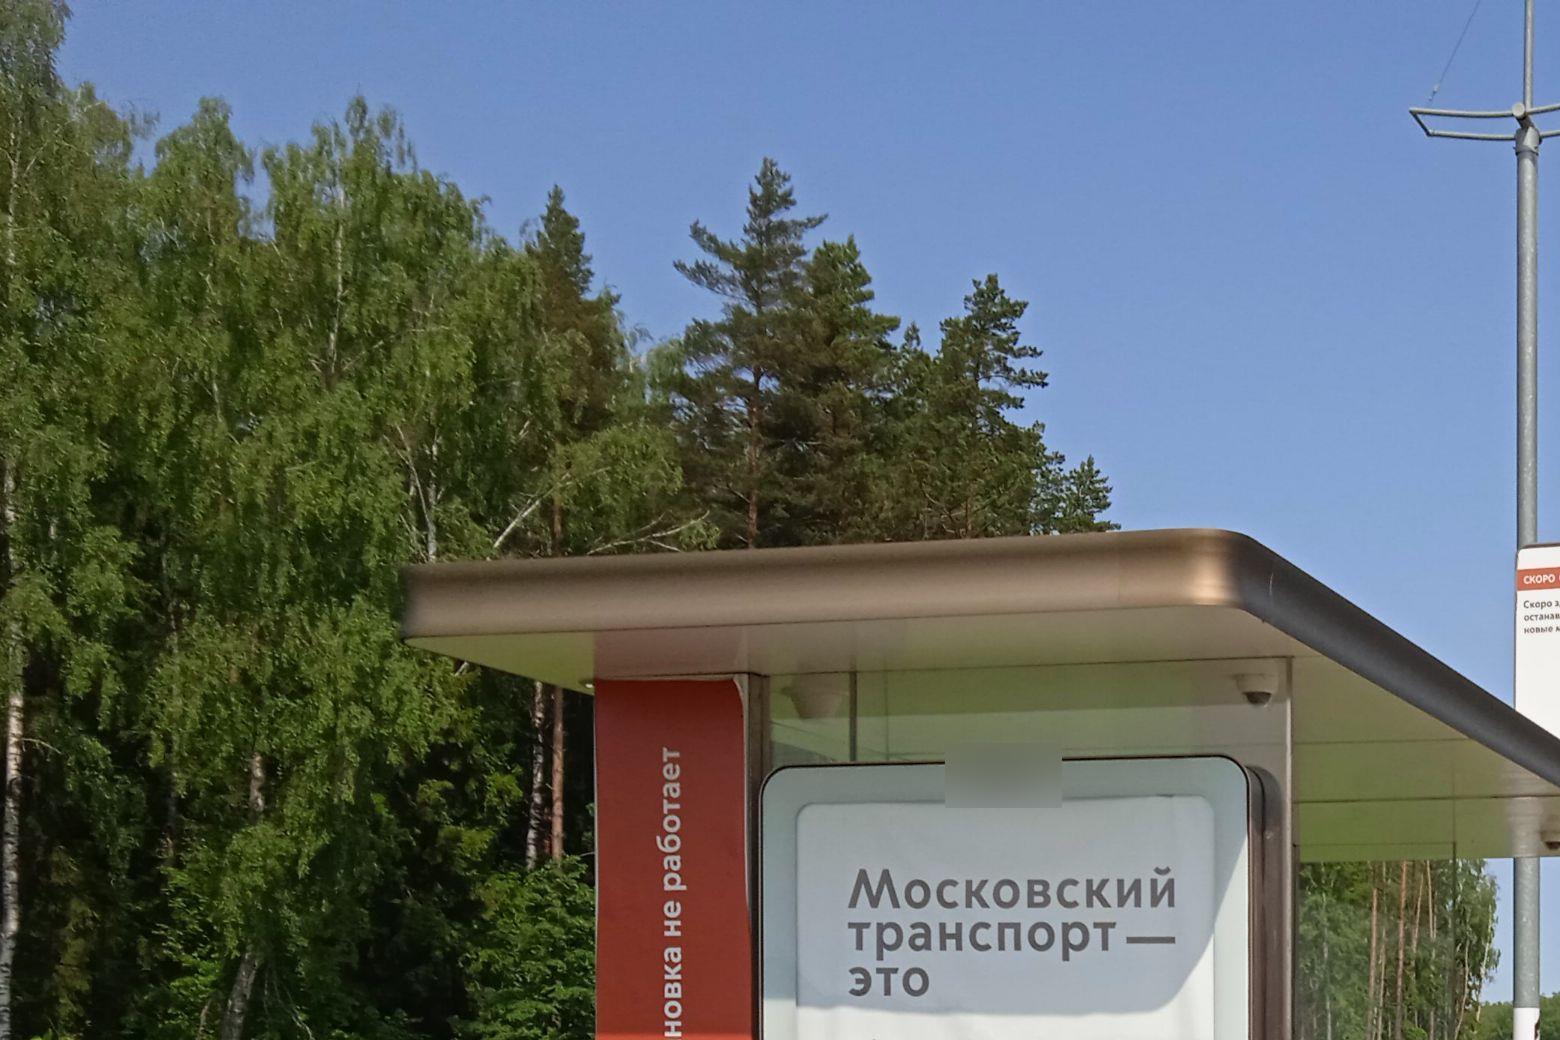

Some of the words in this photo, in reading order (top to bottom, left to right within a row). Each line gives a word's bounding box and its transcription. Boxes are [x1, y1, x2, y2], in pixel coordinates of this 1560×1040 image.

[1523, 574, 1556, 584] СКОРО
[1523, 600, 1552, 609] Скоро
[1524, 626, 1553, 634] новые
[656, 747, 687, 891] работает
[848, 866, 1176, 909] Московский
[663, 900, 682, 937] не
[848, 922, 1117, 961] транспорт
[848, 966, 930, 997] это
